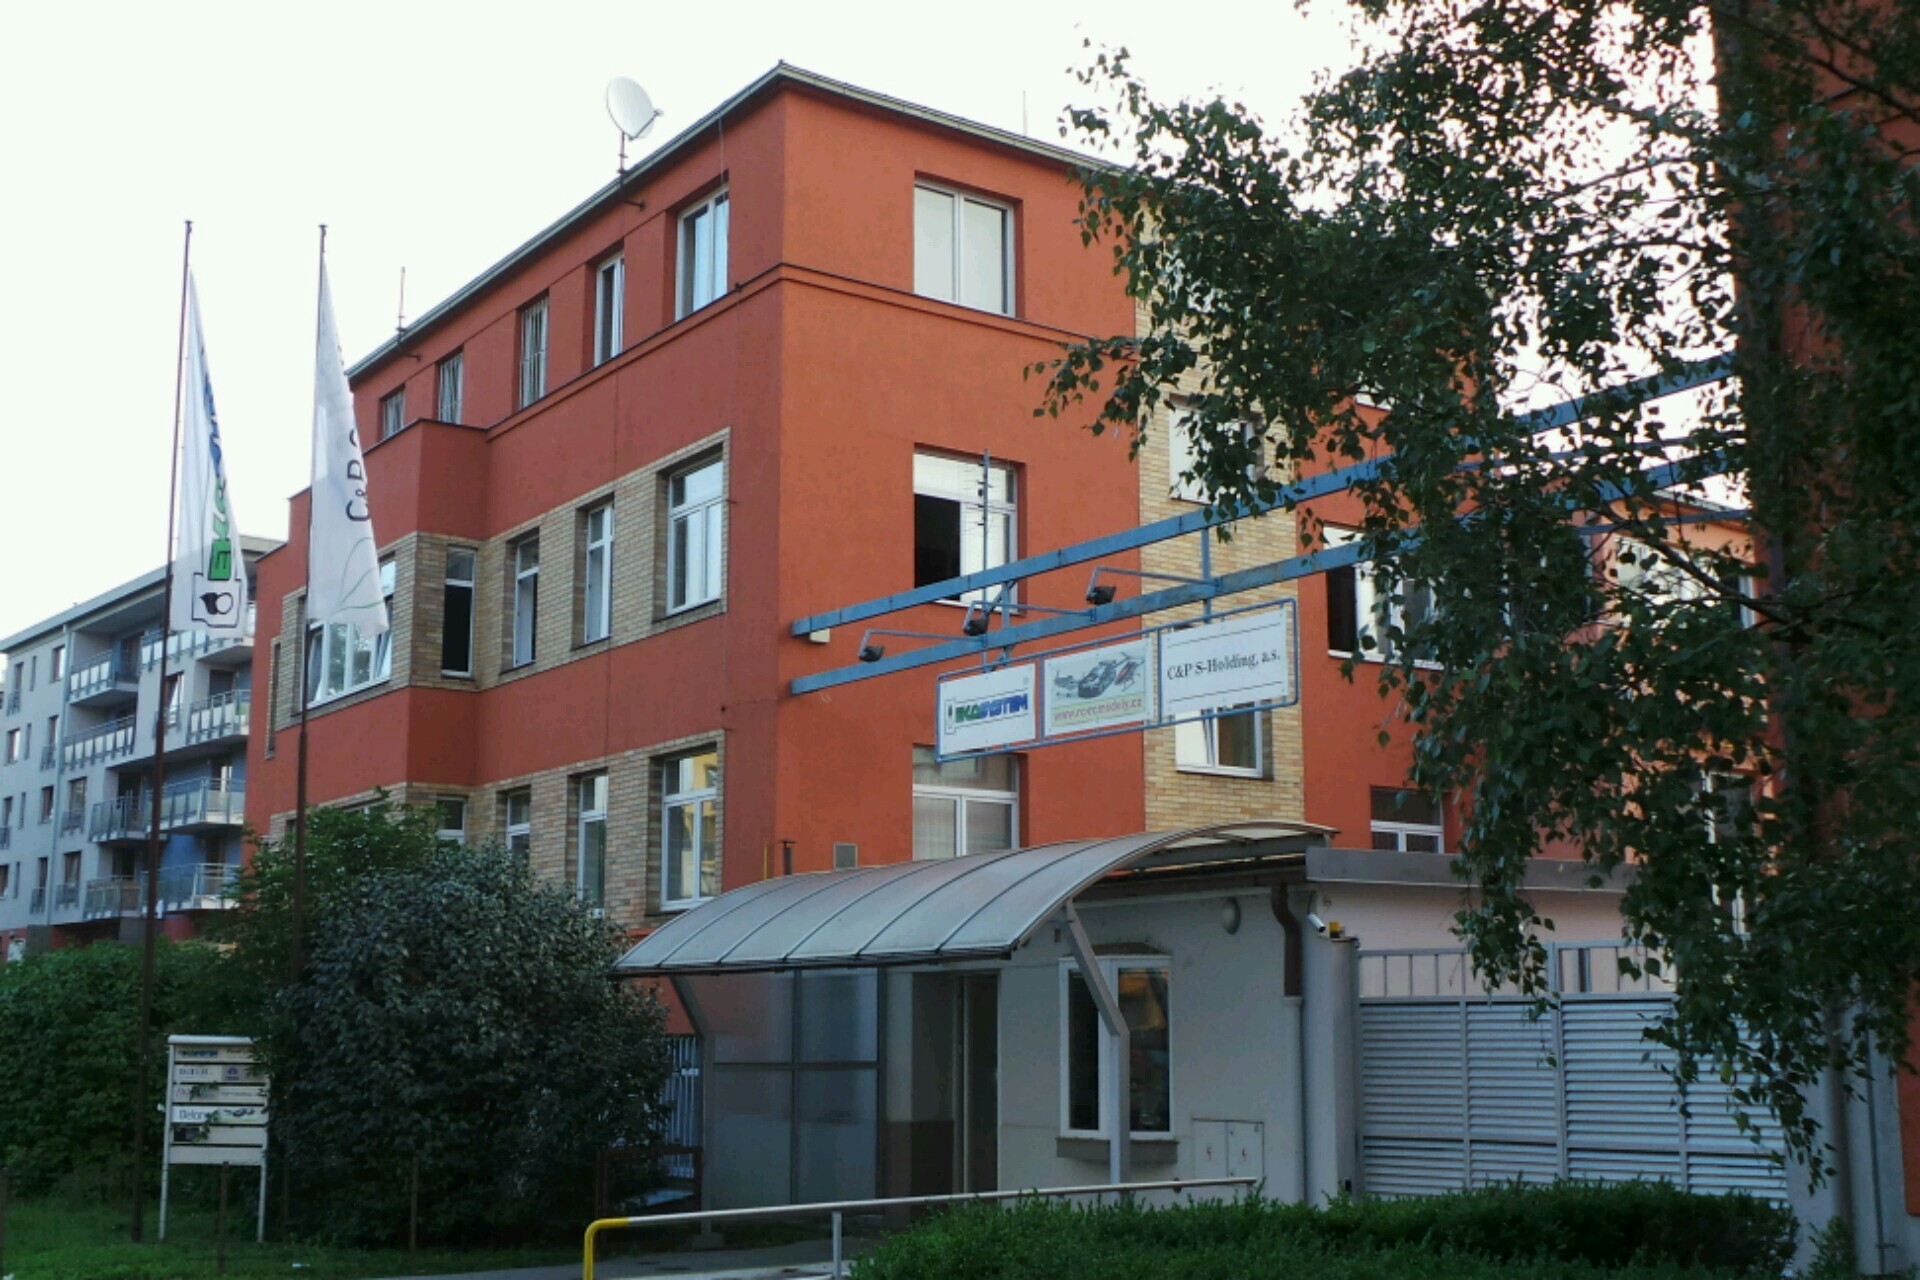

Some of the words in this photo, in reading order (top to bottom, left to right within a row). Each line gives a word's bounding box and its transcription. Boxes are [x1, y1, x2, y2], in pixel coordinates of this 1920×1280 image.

[1167, 663, 1192, 680] C&P
[1195, 653, 1258, 674] S-Holding,
[1262, 650, 1280, 663] a.s.
